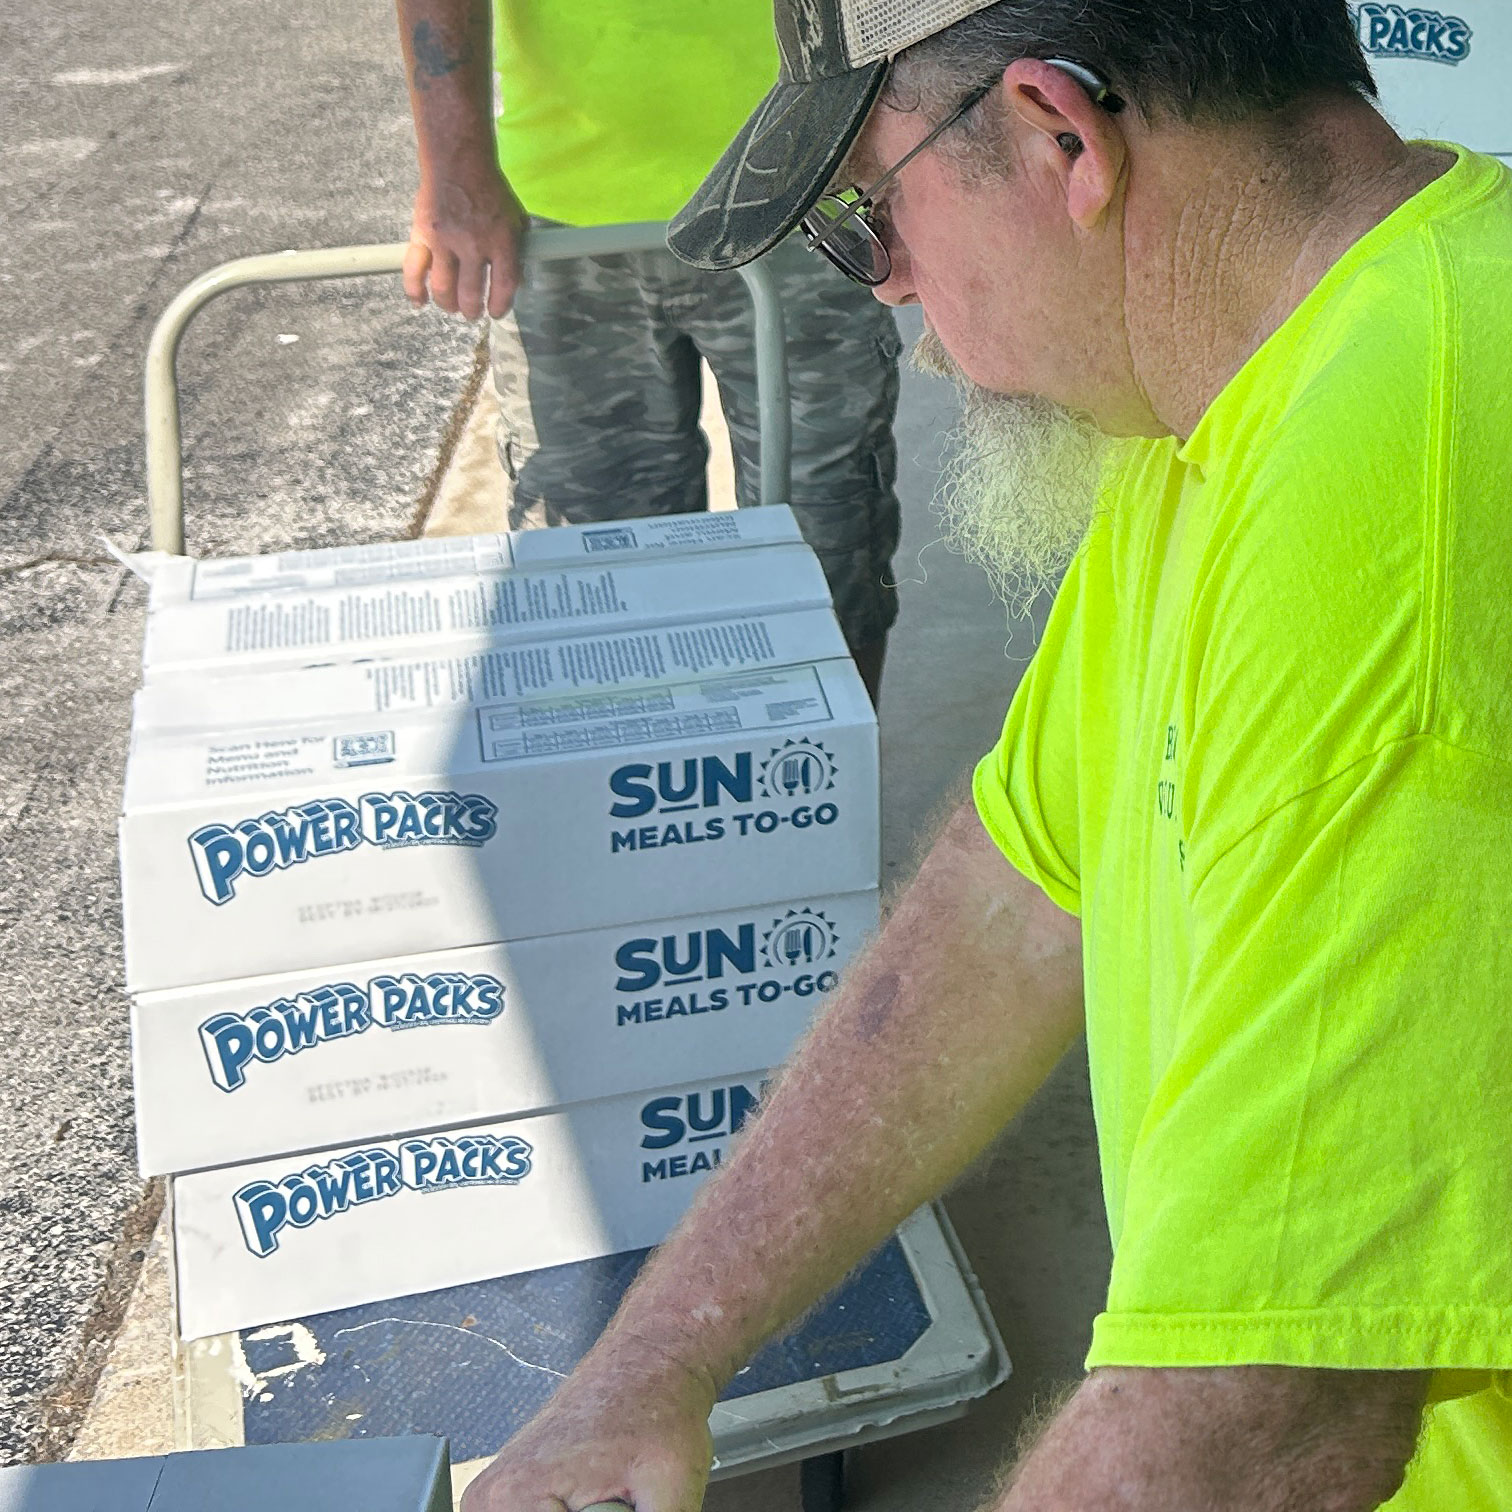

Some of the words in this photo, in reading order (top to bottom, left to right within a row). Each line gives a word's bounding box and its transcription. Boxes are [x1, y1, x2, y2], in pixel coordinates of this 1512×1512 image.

[1359, 2, 1472, 62] PACKS
[187, 799, 360, 906] POWER
[358, 791, 498, 846] PACKS
[609, 752, 753, 819] SUN
[611, 816, 724, 853] MEALS
[733, 802, 839, 837] TO-GO
[198, 983, 369, 1093] POWER
[370, 973, 506, 1028] PACKS
[614, 922, 755, 993] SUN
[617, 991, 728, 1026] MEALS
[736, 970, 839, 1006] TO-GO
[232, 1147, 402, 1258] POWER
[400, 1136, 533, 1188] PACKS
